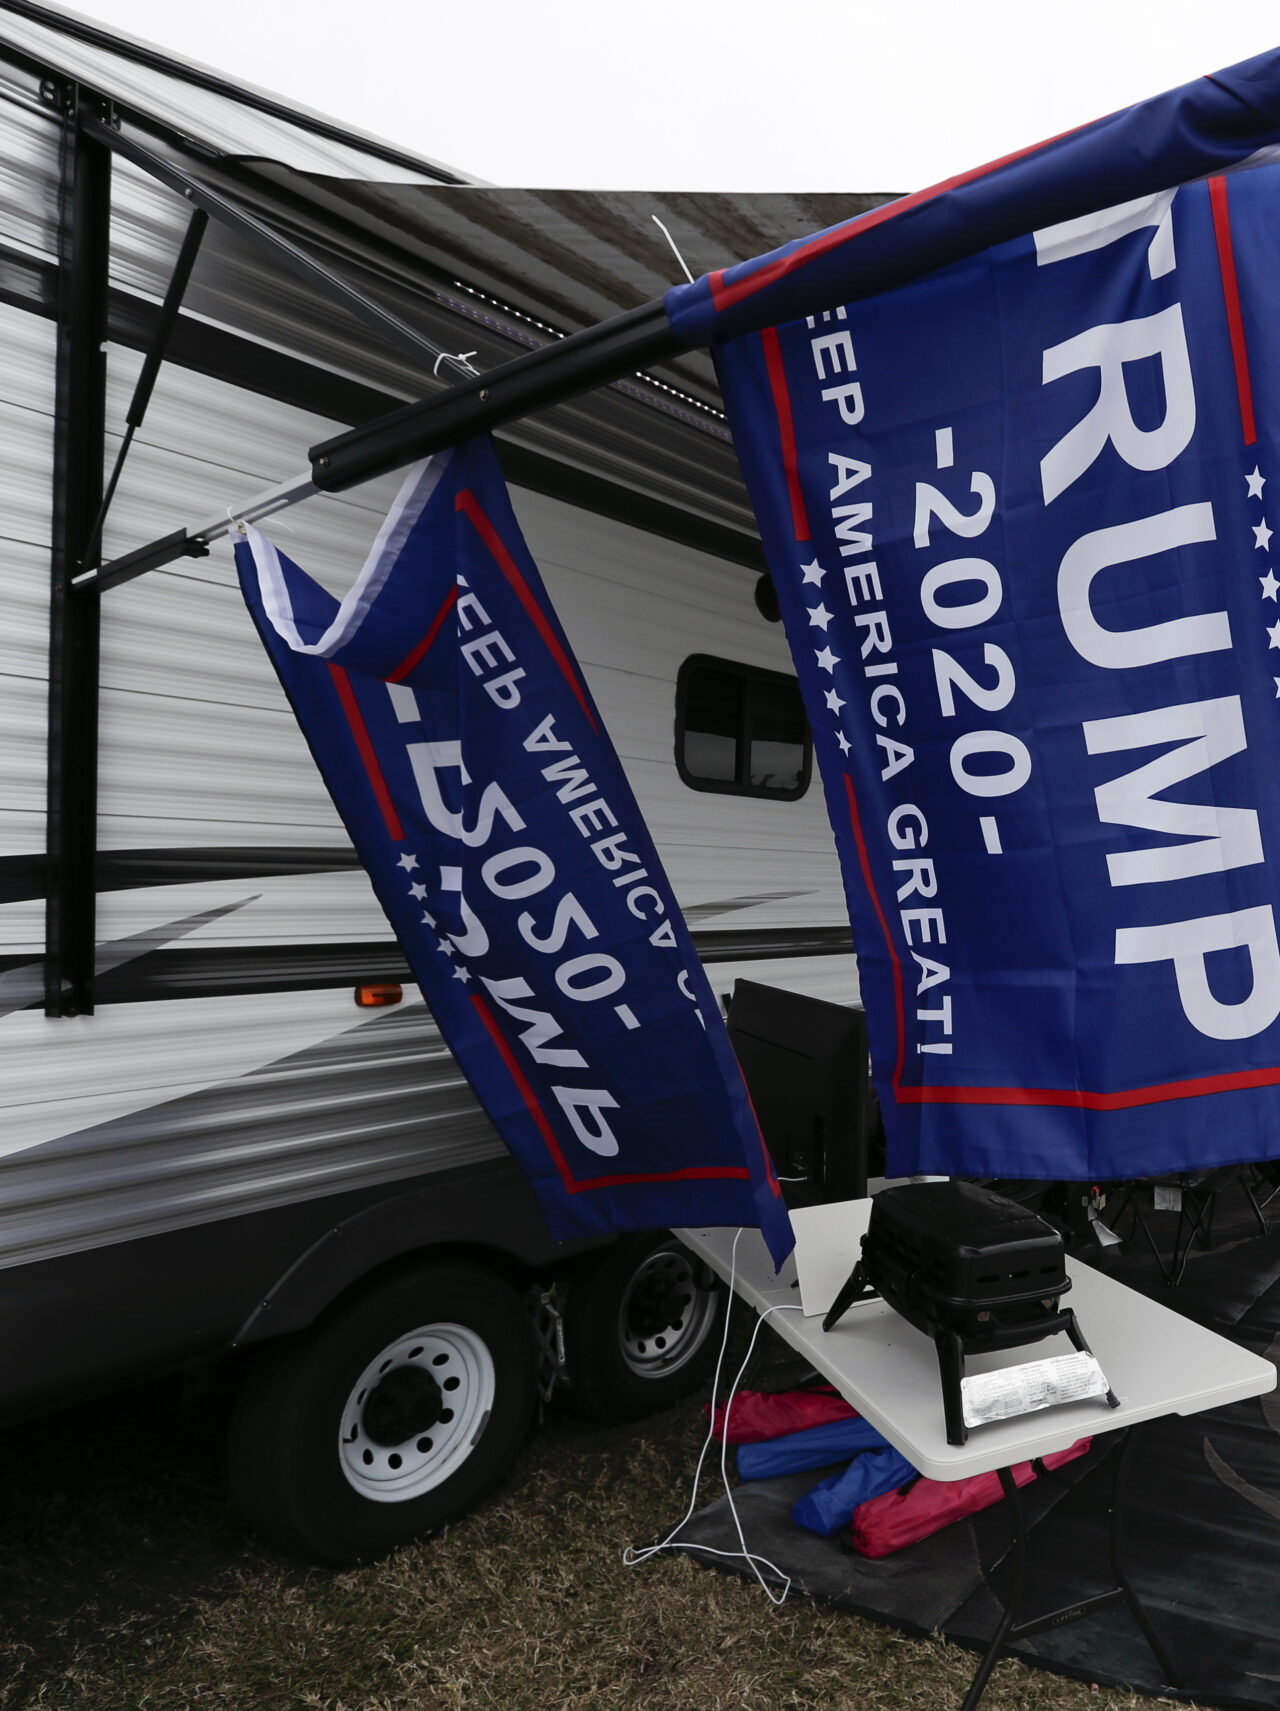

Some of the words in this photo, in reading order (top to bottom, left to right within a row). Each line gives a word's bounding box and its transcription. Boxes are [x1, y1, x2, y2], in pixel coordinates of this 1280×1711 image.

[828, 452, 914, 782] AMERICA
[888, 803, 953, 1055] GREAT!
[913, 427, 1032, 854] -2020-
